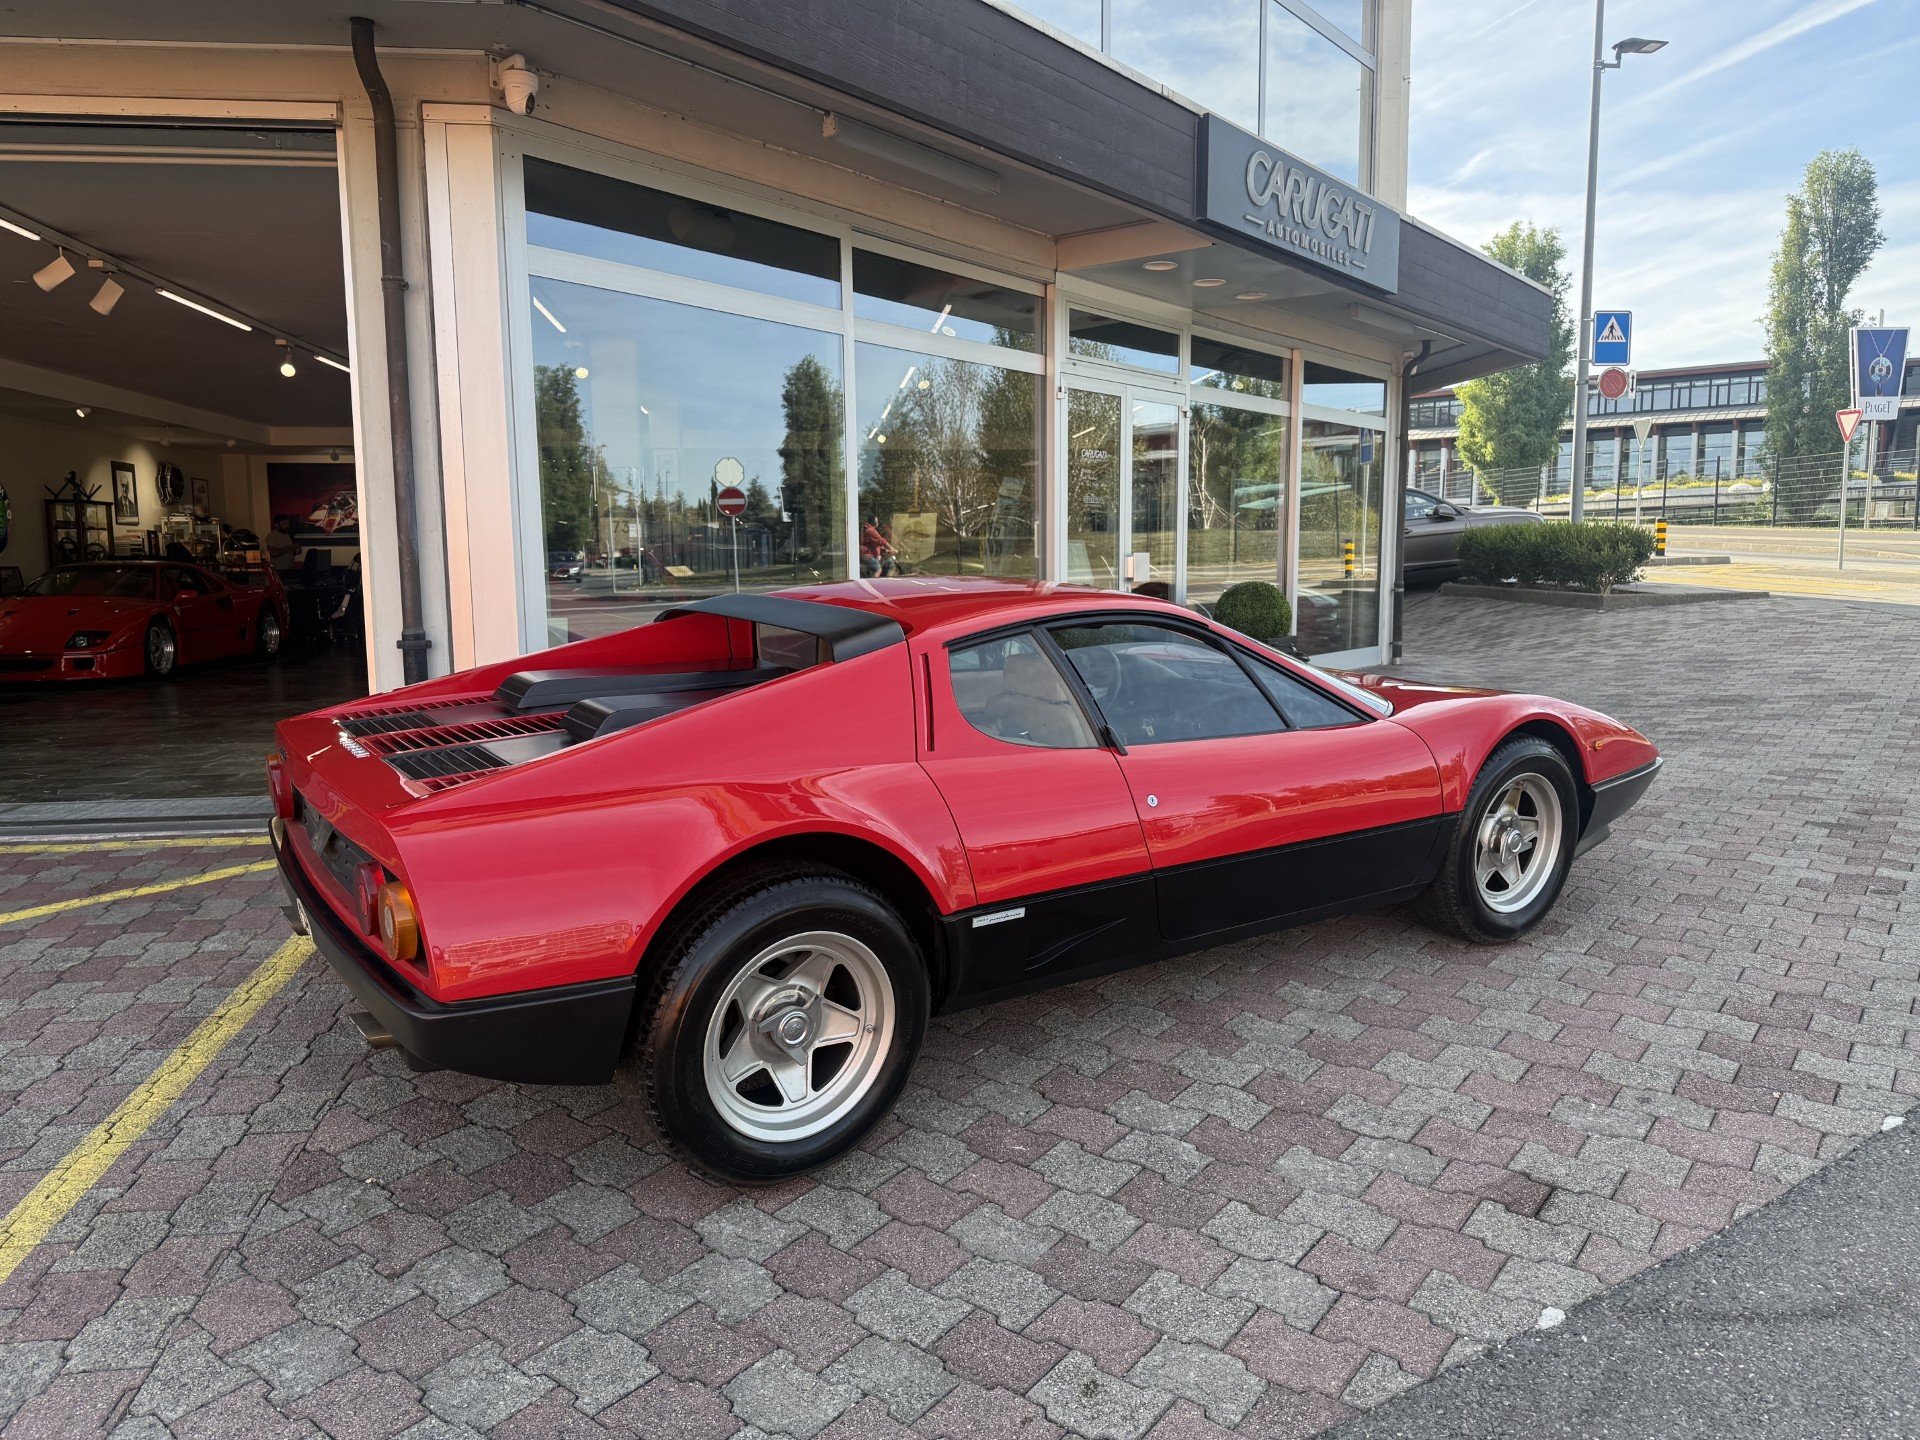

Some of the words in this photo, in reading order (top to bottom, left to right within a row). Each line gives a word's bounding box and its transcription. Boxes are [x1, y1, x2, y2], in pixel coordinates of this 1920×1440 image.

[1246, 150, 1376, 254] CARUGATI
[1266, 219, 1351, 266] AUTOMOBILES
[1865, 400, 1893, 414] PIAGET
